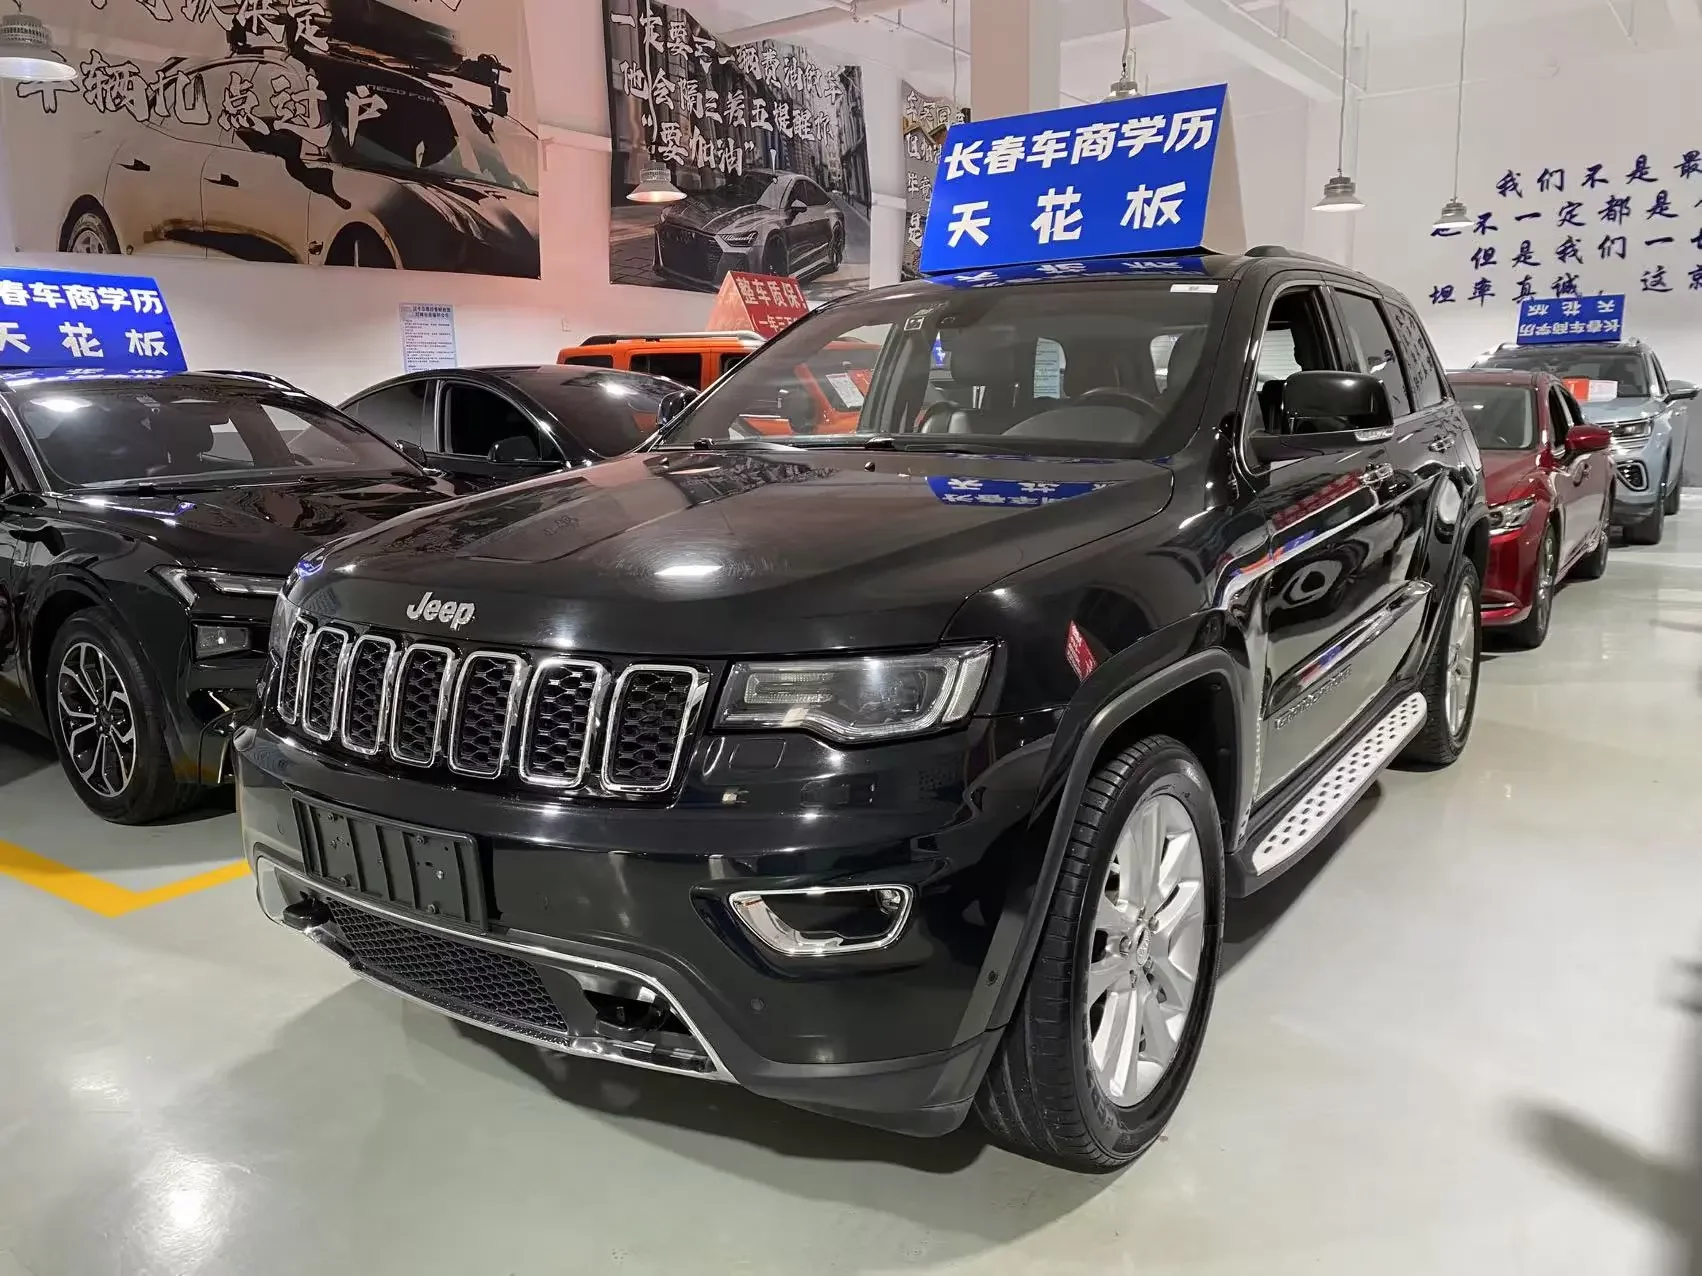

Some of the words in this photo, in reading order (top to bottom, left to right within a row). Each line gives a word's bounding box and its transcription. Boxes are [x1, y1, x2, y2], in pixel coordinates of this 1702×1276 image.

[619, 60, 834, 142] 他会隔三差五提醒你
[944, 108, 1217, 180] 长春车商学历
[1496, 150, 1702, 198] 我们不是最
[948, 181, 1187, 248] 天花板
[1431, 189, 1702, 237] 不一定都是
[1519, 319, 1620, 336] 长春车商学历
[1528, 300, 1615, 316] 天花板
[406, 591, 475, 631] Jeep
